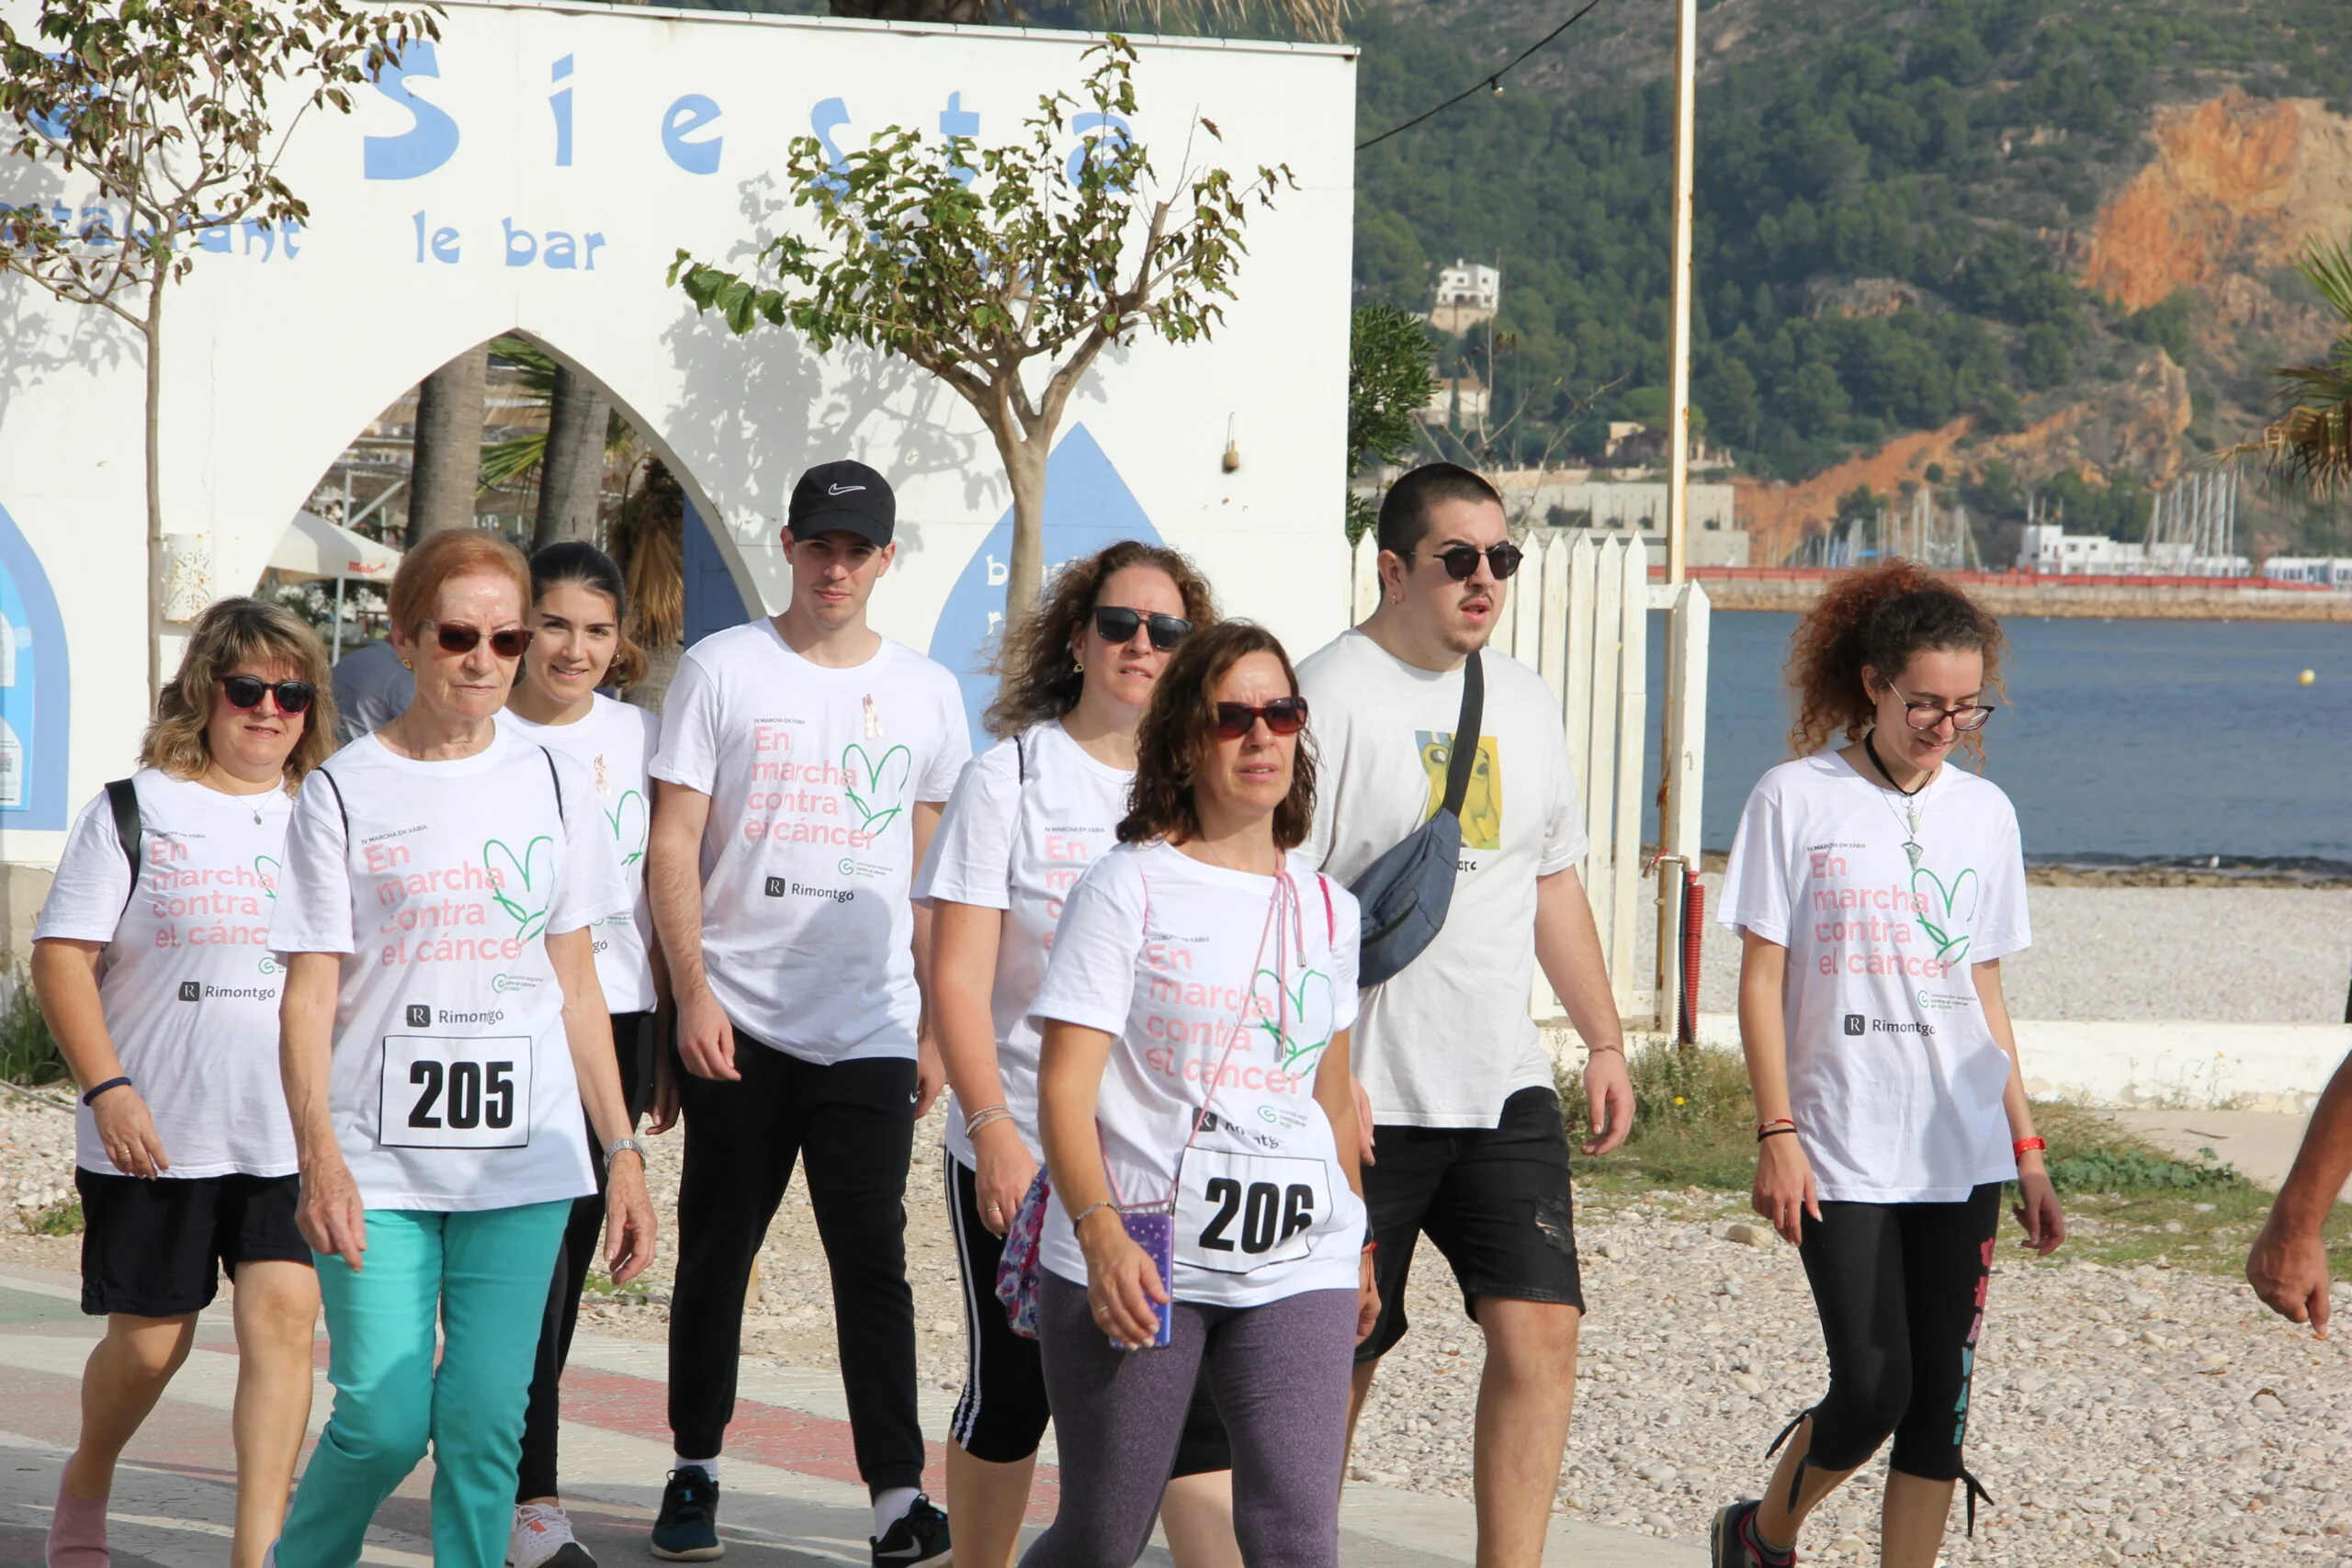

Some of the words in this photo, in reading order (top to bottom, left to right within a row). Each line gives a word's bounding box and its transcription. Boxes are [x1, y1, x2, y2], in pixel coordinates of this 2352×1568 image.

[412, 210, 460, 264] le
[503, 217, 606, 271] bar
[753, 726, 790, 751] En
[752, 760, 858, 787] marcha
[747, 789, 839, 816] contra
[368, 831, 397, 843] MARCHA
[397, 829, 407, 837] EN
[743, 816, 771, 840] el
[774, 817, 876, 850] cáncer
[150, 840, 188, 864] En
[363, 843, 411, 874] En
[1046, 835, 1088, 861] En
[153, 865, 277, 892] marcha
[1809, 852, 1848, 879] En
[376, 860, 506, 907] marcha
[153, 889, 260, 919] contra
[1814, 884, 1929, 913] marcha
[155, 922, 182, 948] el
[187, 919, 270, 945] cánc
[1815, 916, 1911, 943] contra
[381, 936, 408, 966] el
[1145, 943, 1193, 971] En
[1818, 947, 1838, 975] el
[1847, 946, 1951, 979] cáncer
[205, 986, 276, 1001] Rimontgó
[1145, 1045, 1175, 1077] el
[408, 1060, 514, 1129] 205
[1198, 1177, 1315, 1255] 206
